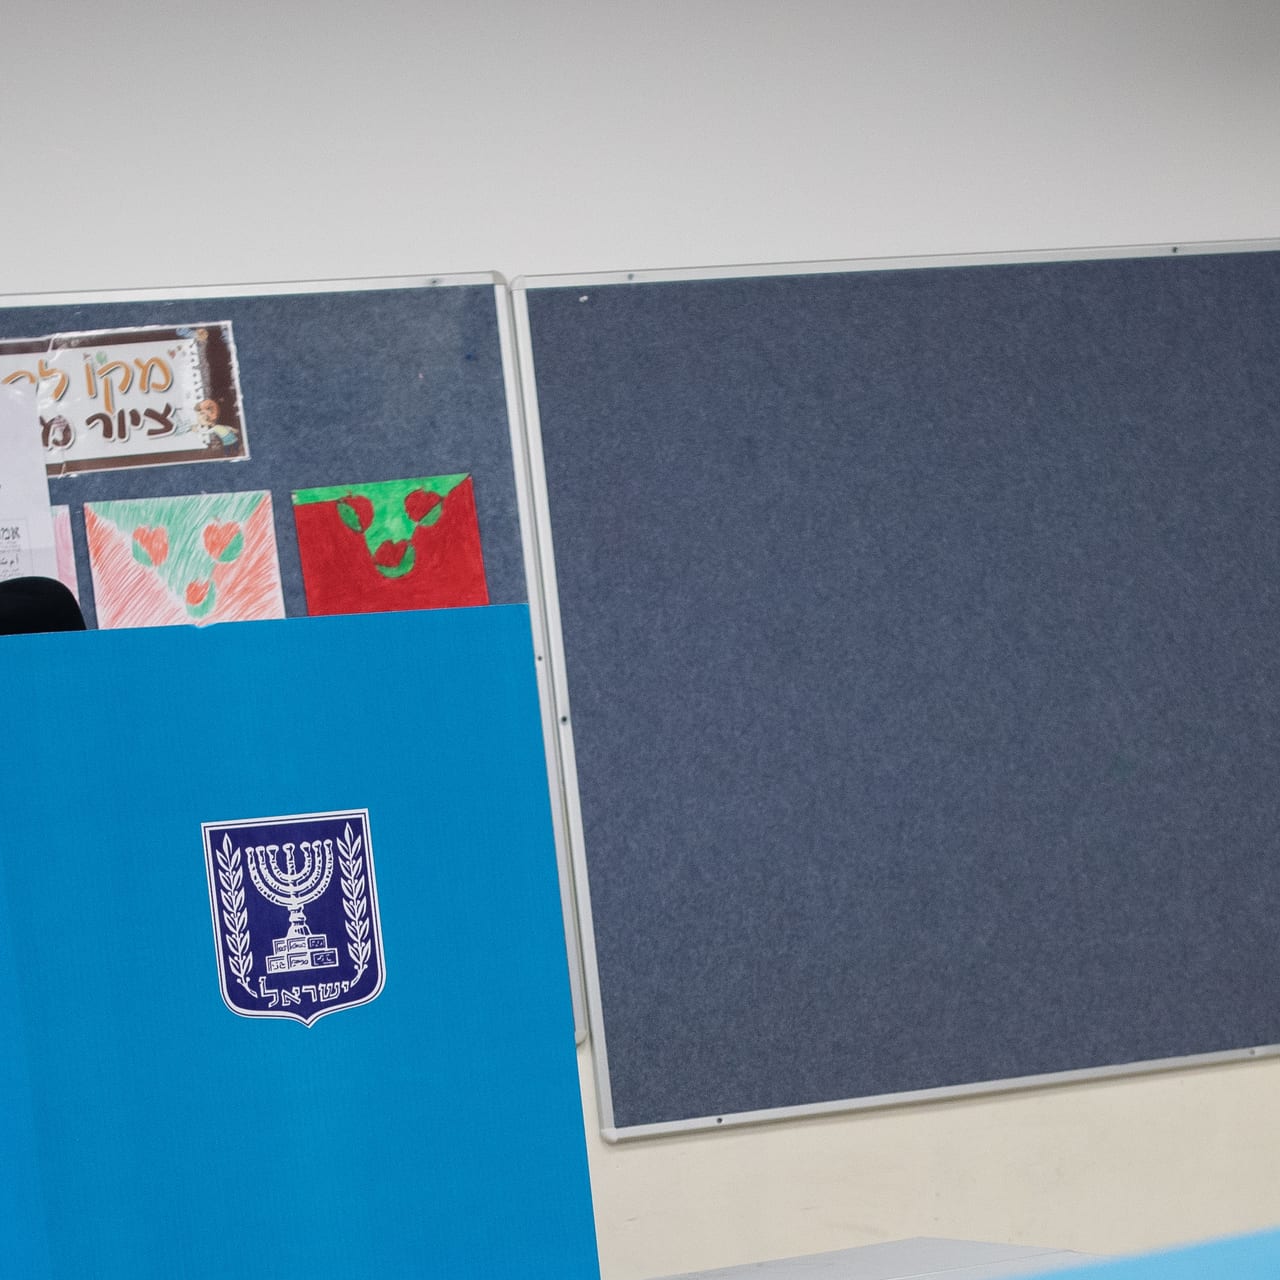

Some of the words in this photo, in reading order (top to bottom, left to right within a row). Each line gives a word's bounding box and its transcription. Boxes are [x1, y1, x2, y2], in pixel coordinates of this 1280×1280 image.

[39, 415, 73, 449] מ
[85, 403, 176, 442] ציור
[259, 976, 350, 1008] ישראל
